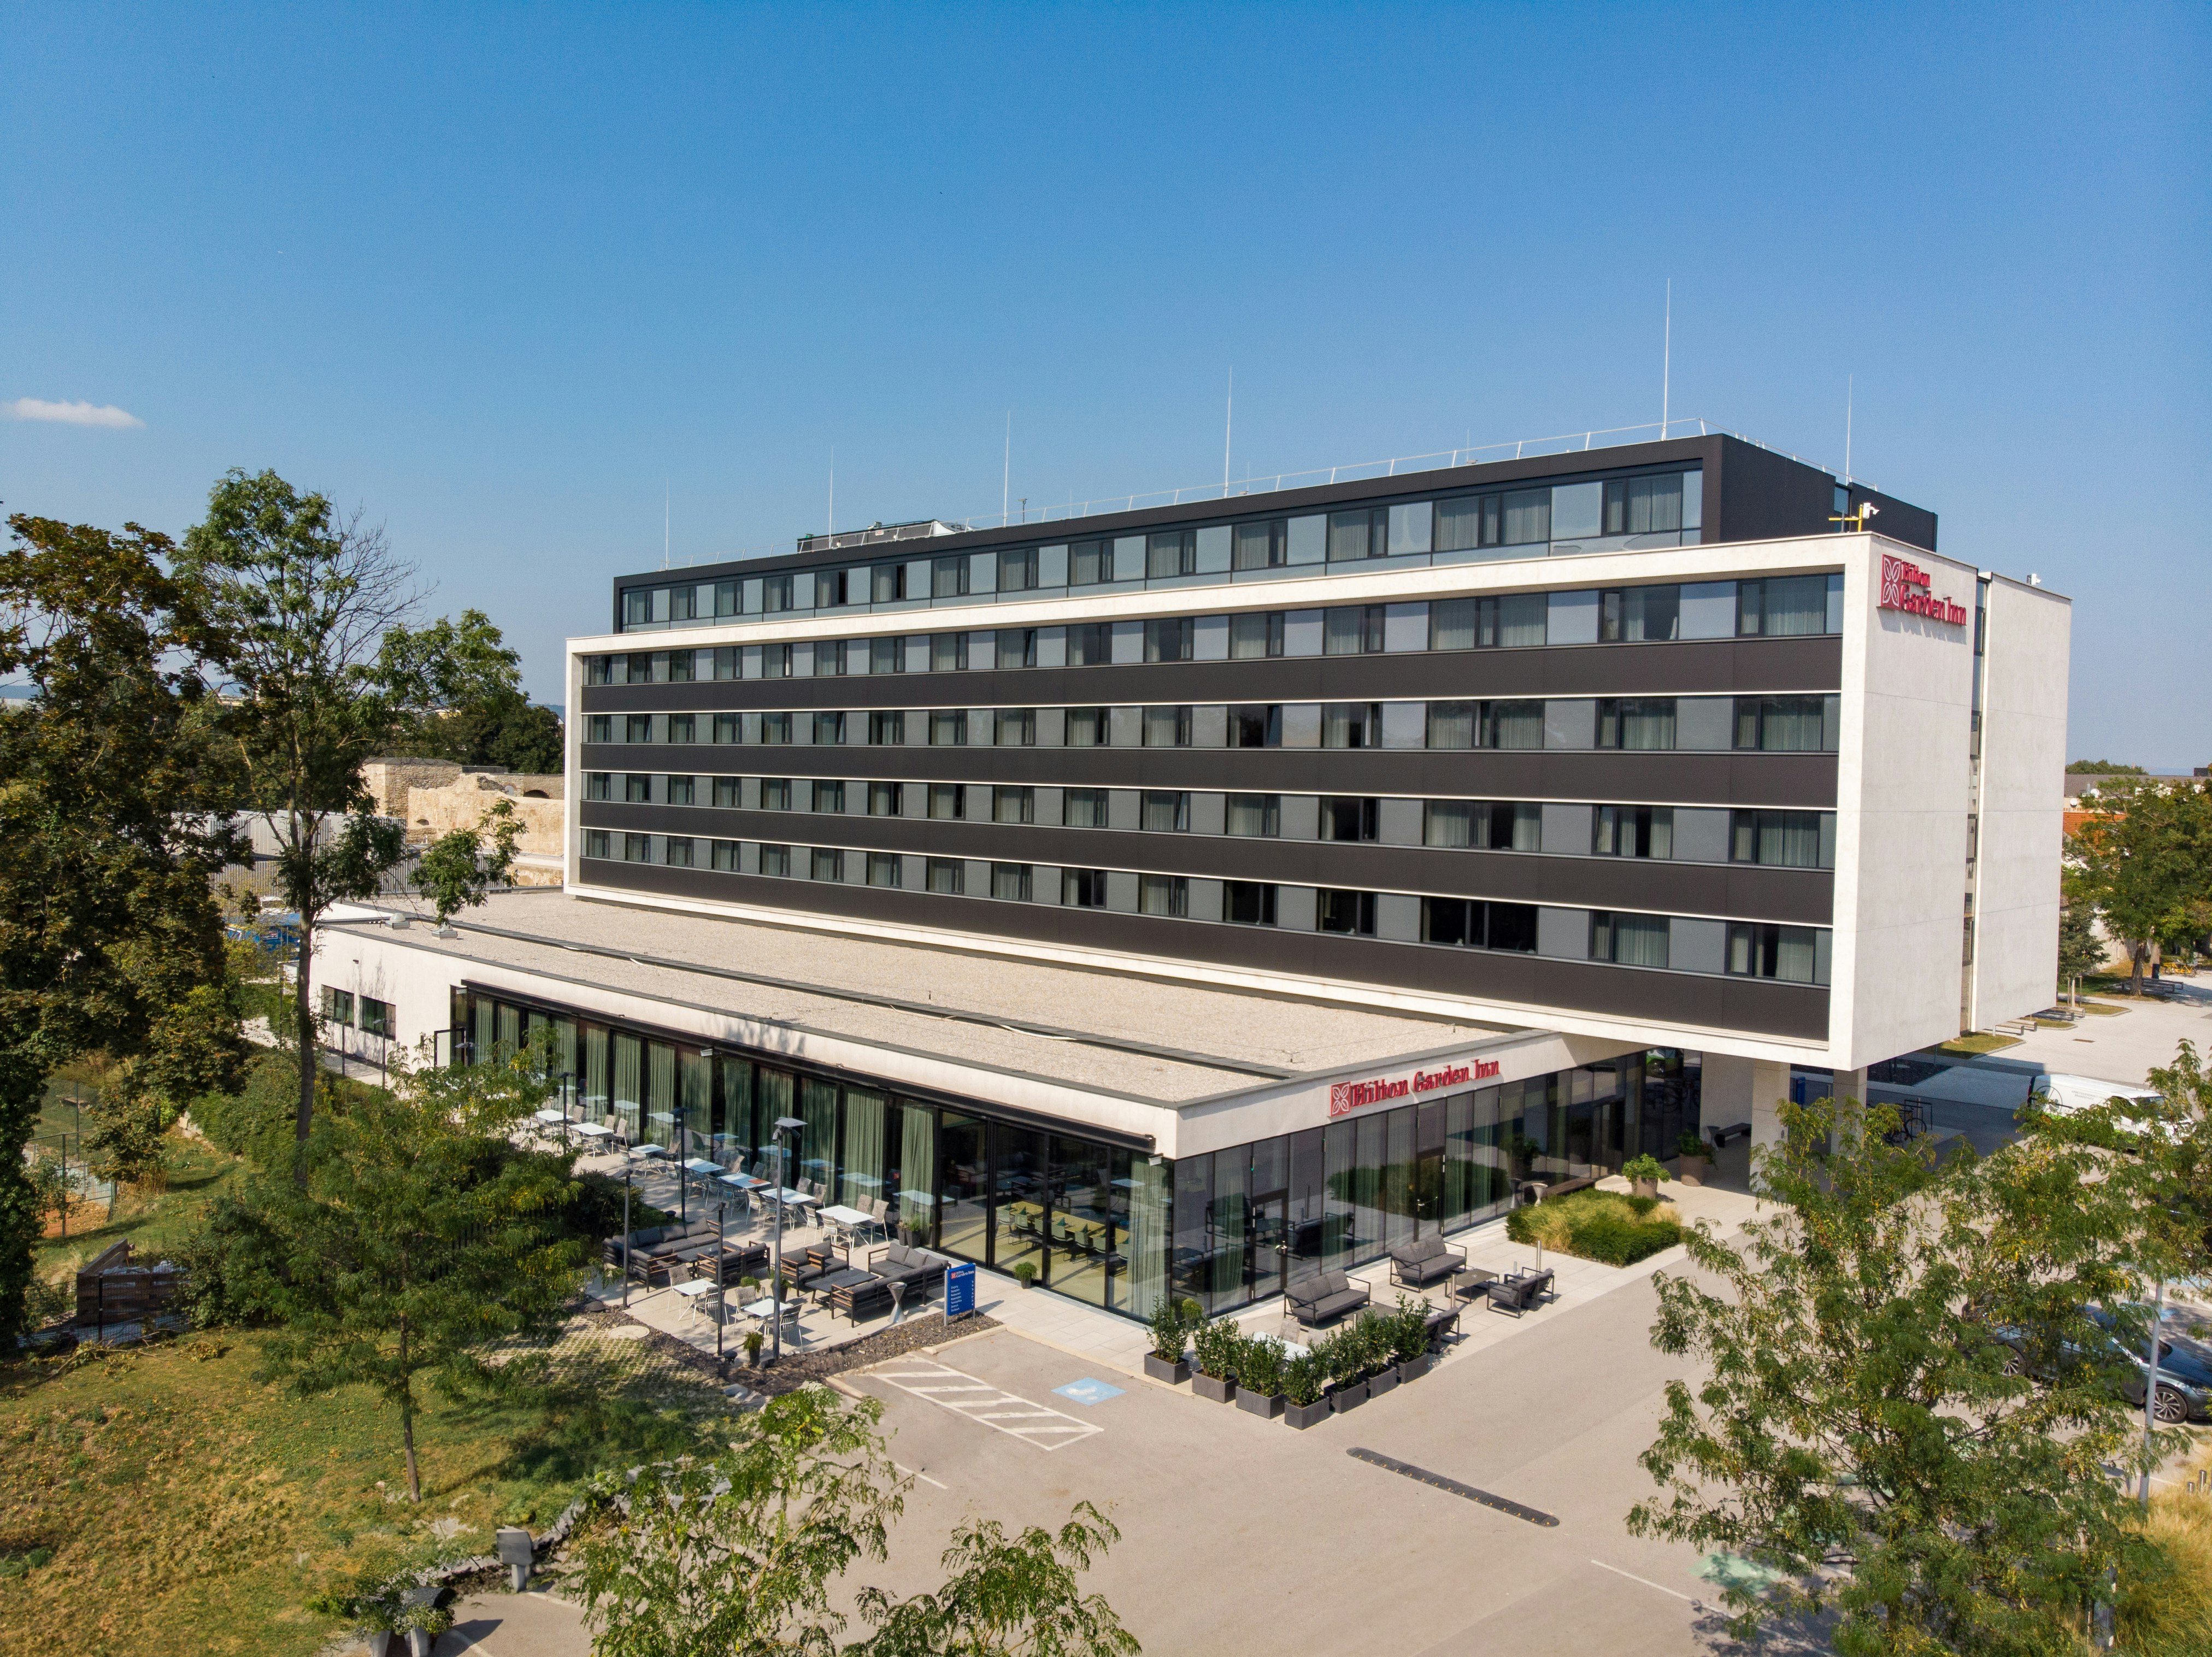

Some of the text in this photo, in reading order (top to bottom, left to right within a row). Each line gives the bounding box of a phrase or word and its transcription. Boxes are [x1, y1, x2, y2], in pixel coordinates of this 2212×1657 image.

[1901, 584, 1967, 626] Garden Inn
[1352, 1059, 1500, 1107] Hilton Garden Inn
